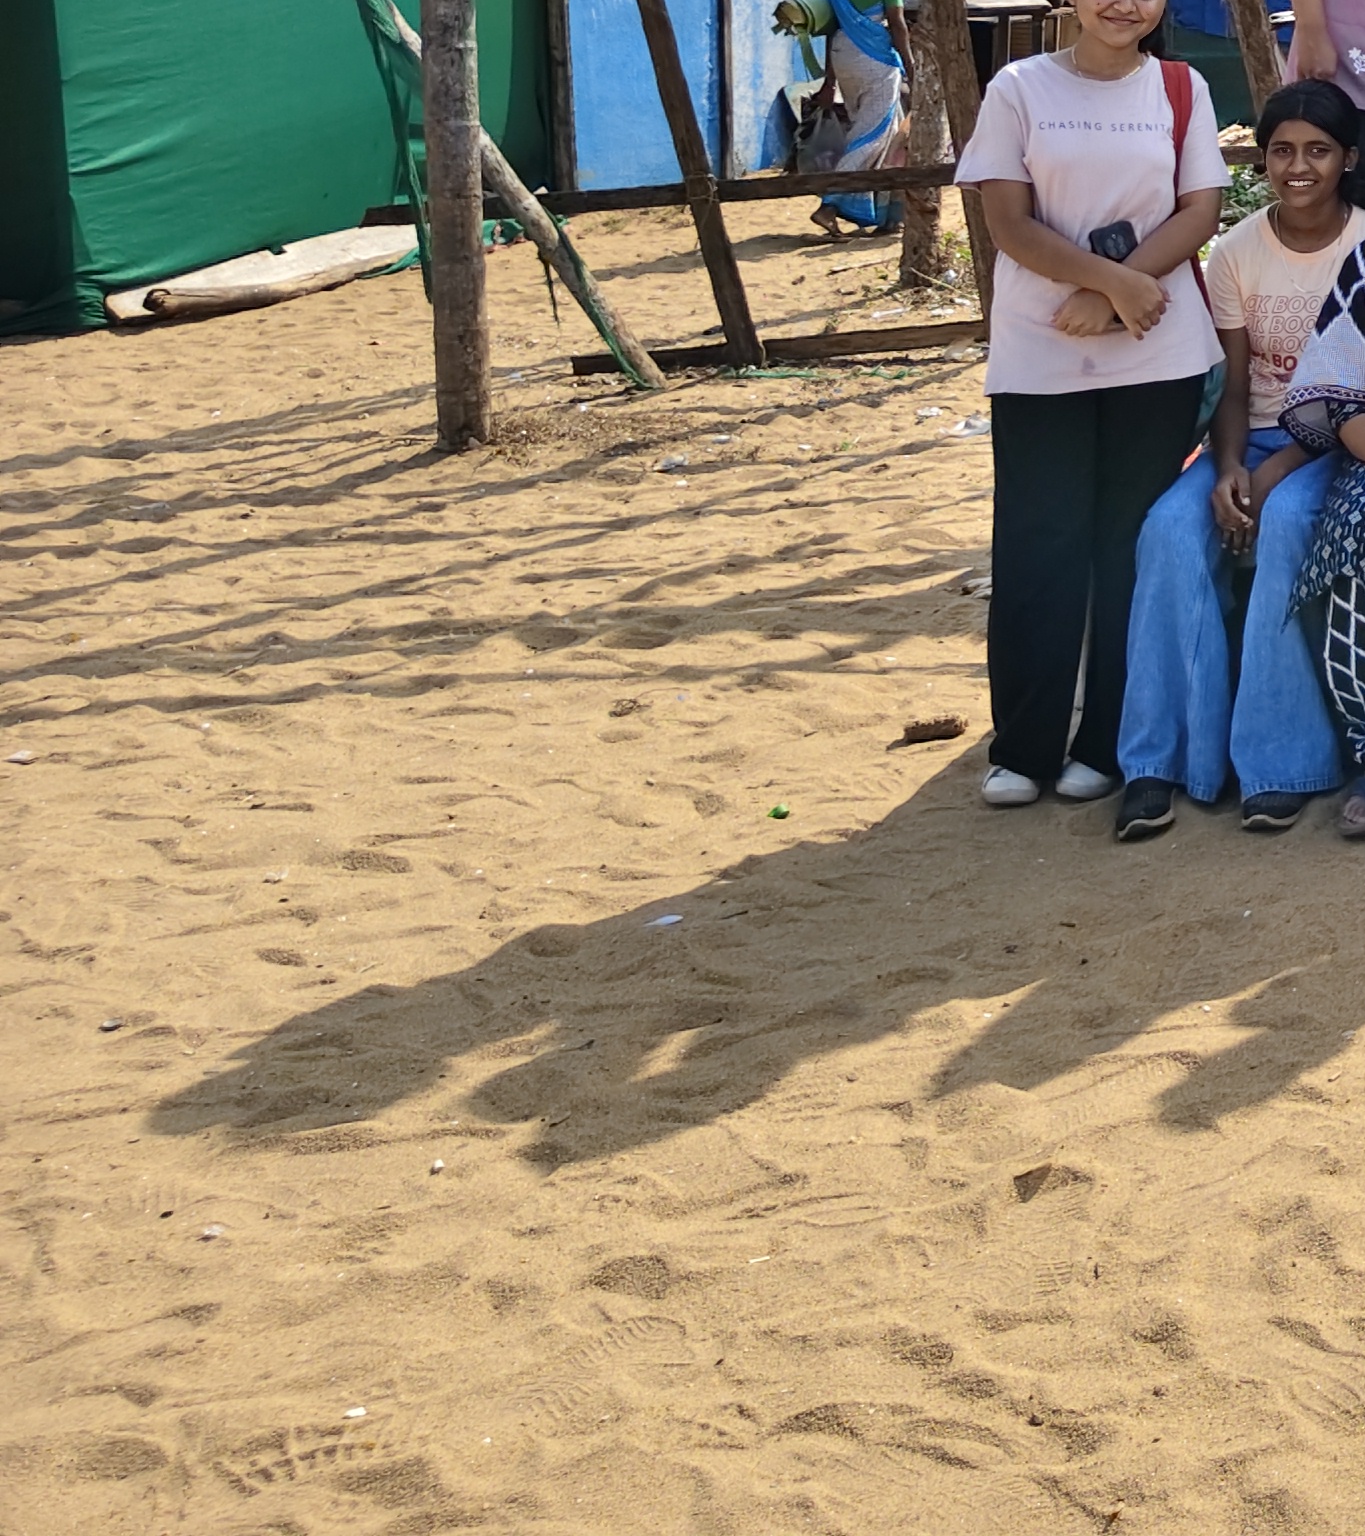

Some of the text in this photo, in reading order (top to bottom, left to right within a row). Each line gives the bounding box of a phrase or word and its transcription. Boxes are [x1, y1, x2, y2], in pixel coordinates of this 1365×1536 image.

[1038, 120, 1172, 133] CHASING SERENIT
[1271, 295, 1329, 314] BOO
